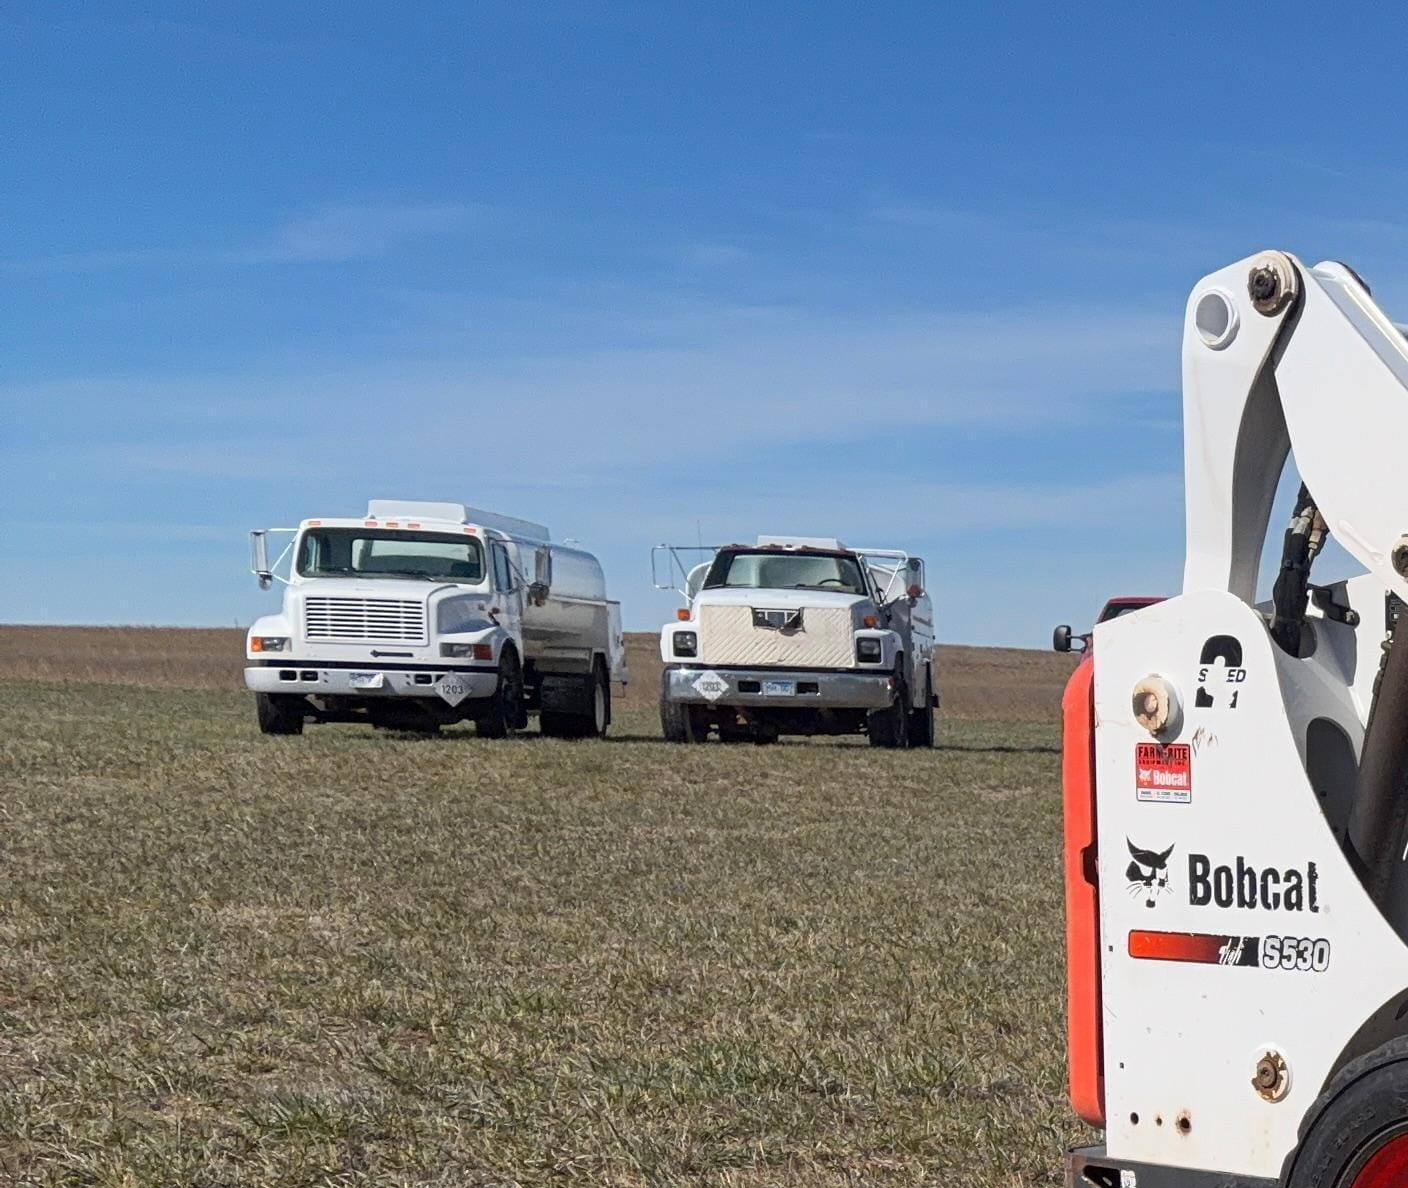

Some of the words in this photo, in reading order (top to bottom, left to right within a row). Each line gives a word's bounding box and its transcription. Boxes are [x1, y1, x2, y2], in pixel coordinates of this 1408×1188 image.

[1198, 668, 1247, 683] SED
[441, 684, 464, 695] 1203
[1153, 769, 1187, 787] Bobcat
[1188, 854, 1319, 913] Bobcat
[1263, 935, 1331, 973] S530
